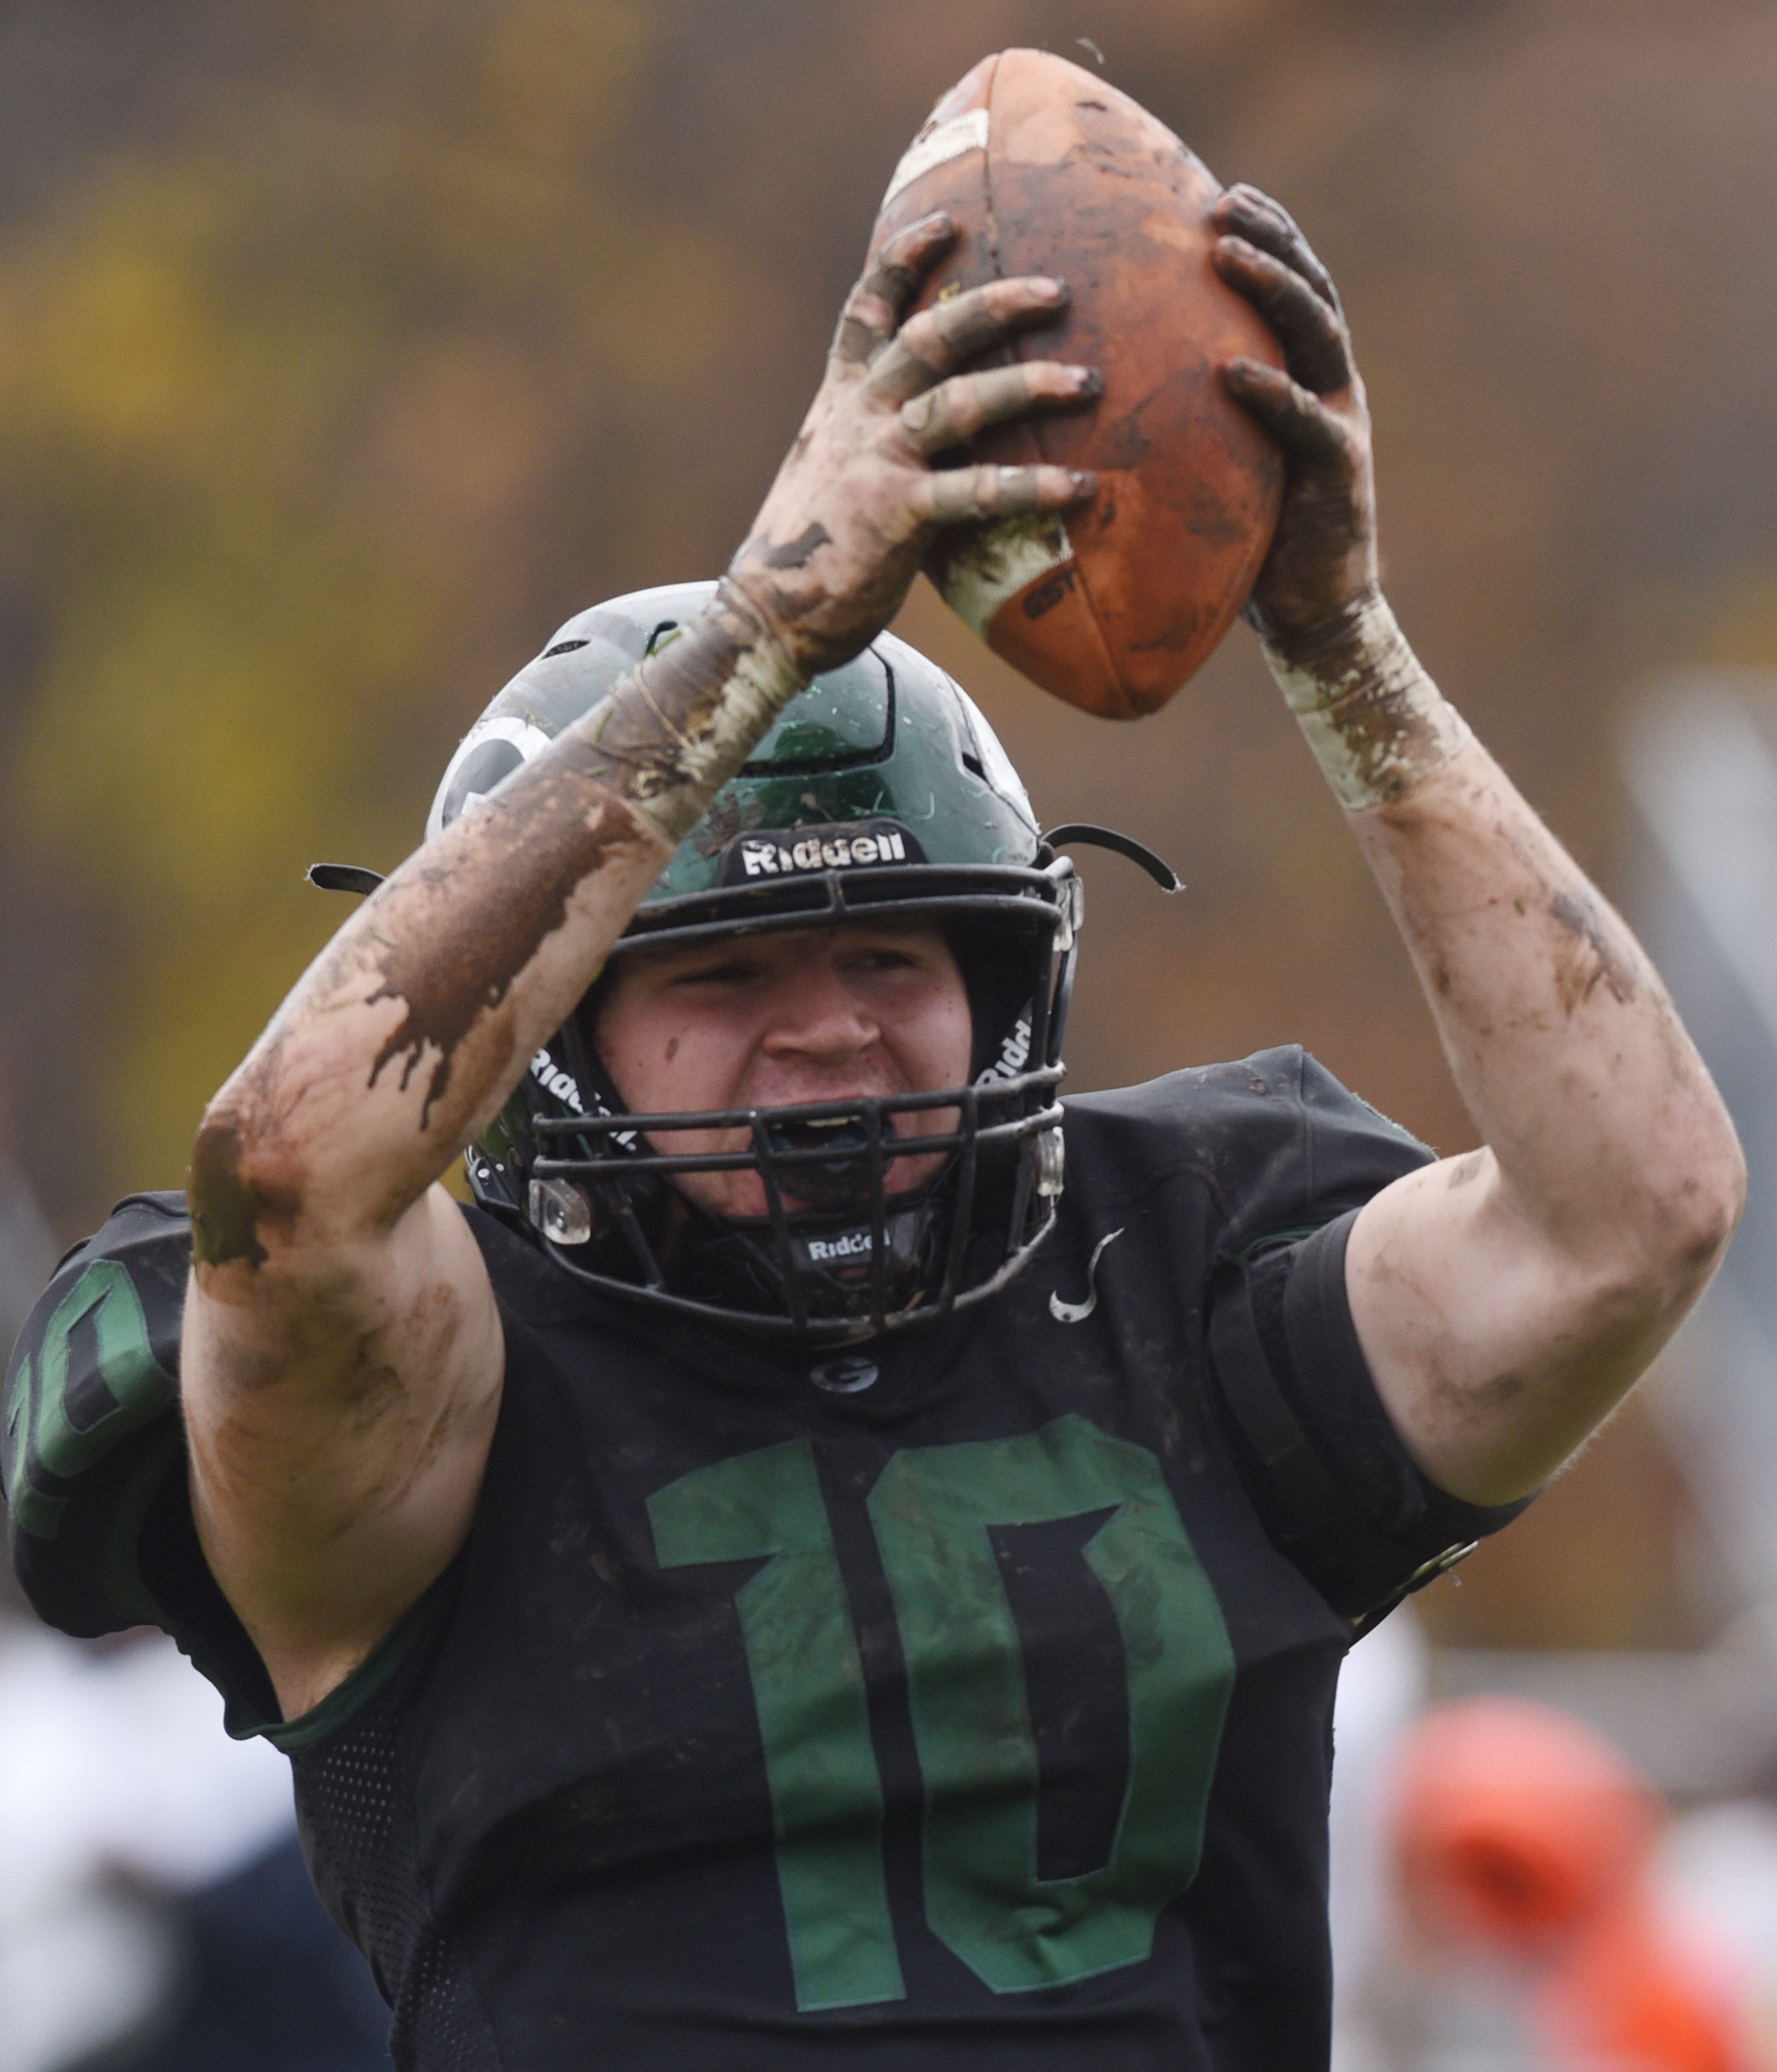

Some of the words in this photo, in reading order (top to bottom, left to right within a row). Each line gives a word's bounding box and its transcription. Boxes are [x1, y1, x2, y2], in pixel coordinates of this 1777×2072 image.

[742, 833, 906, 875] Riddell
[810, 1358, 879, 1393] G
[645, 1413, 1236, 2012] 10
